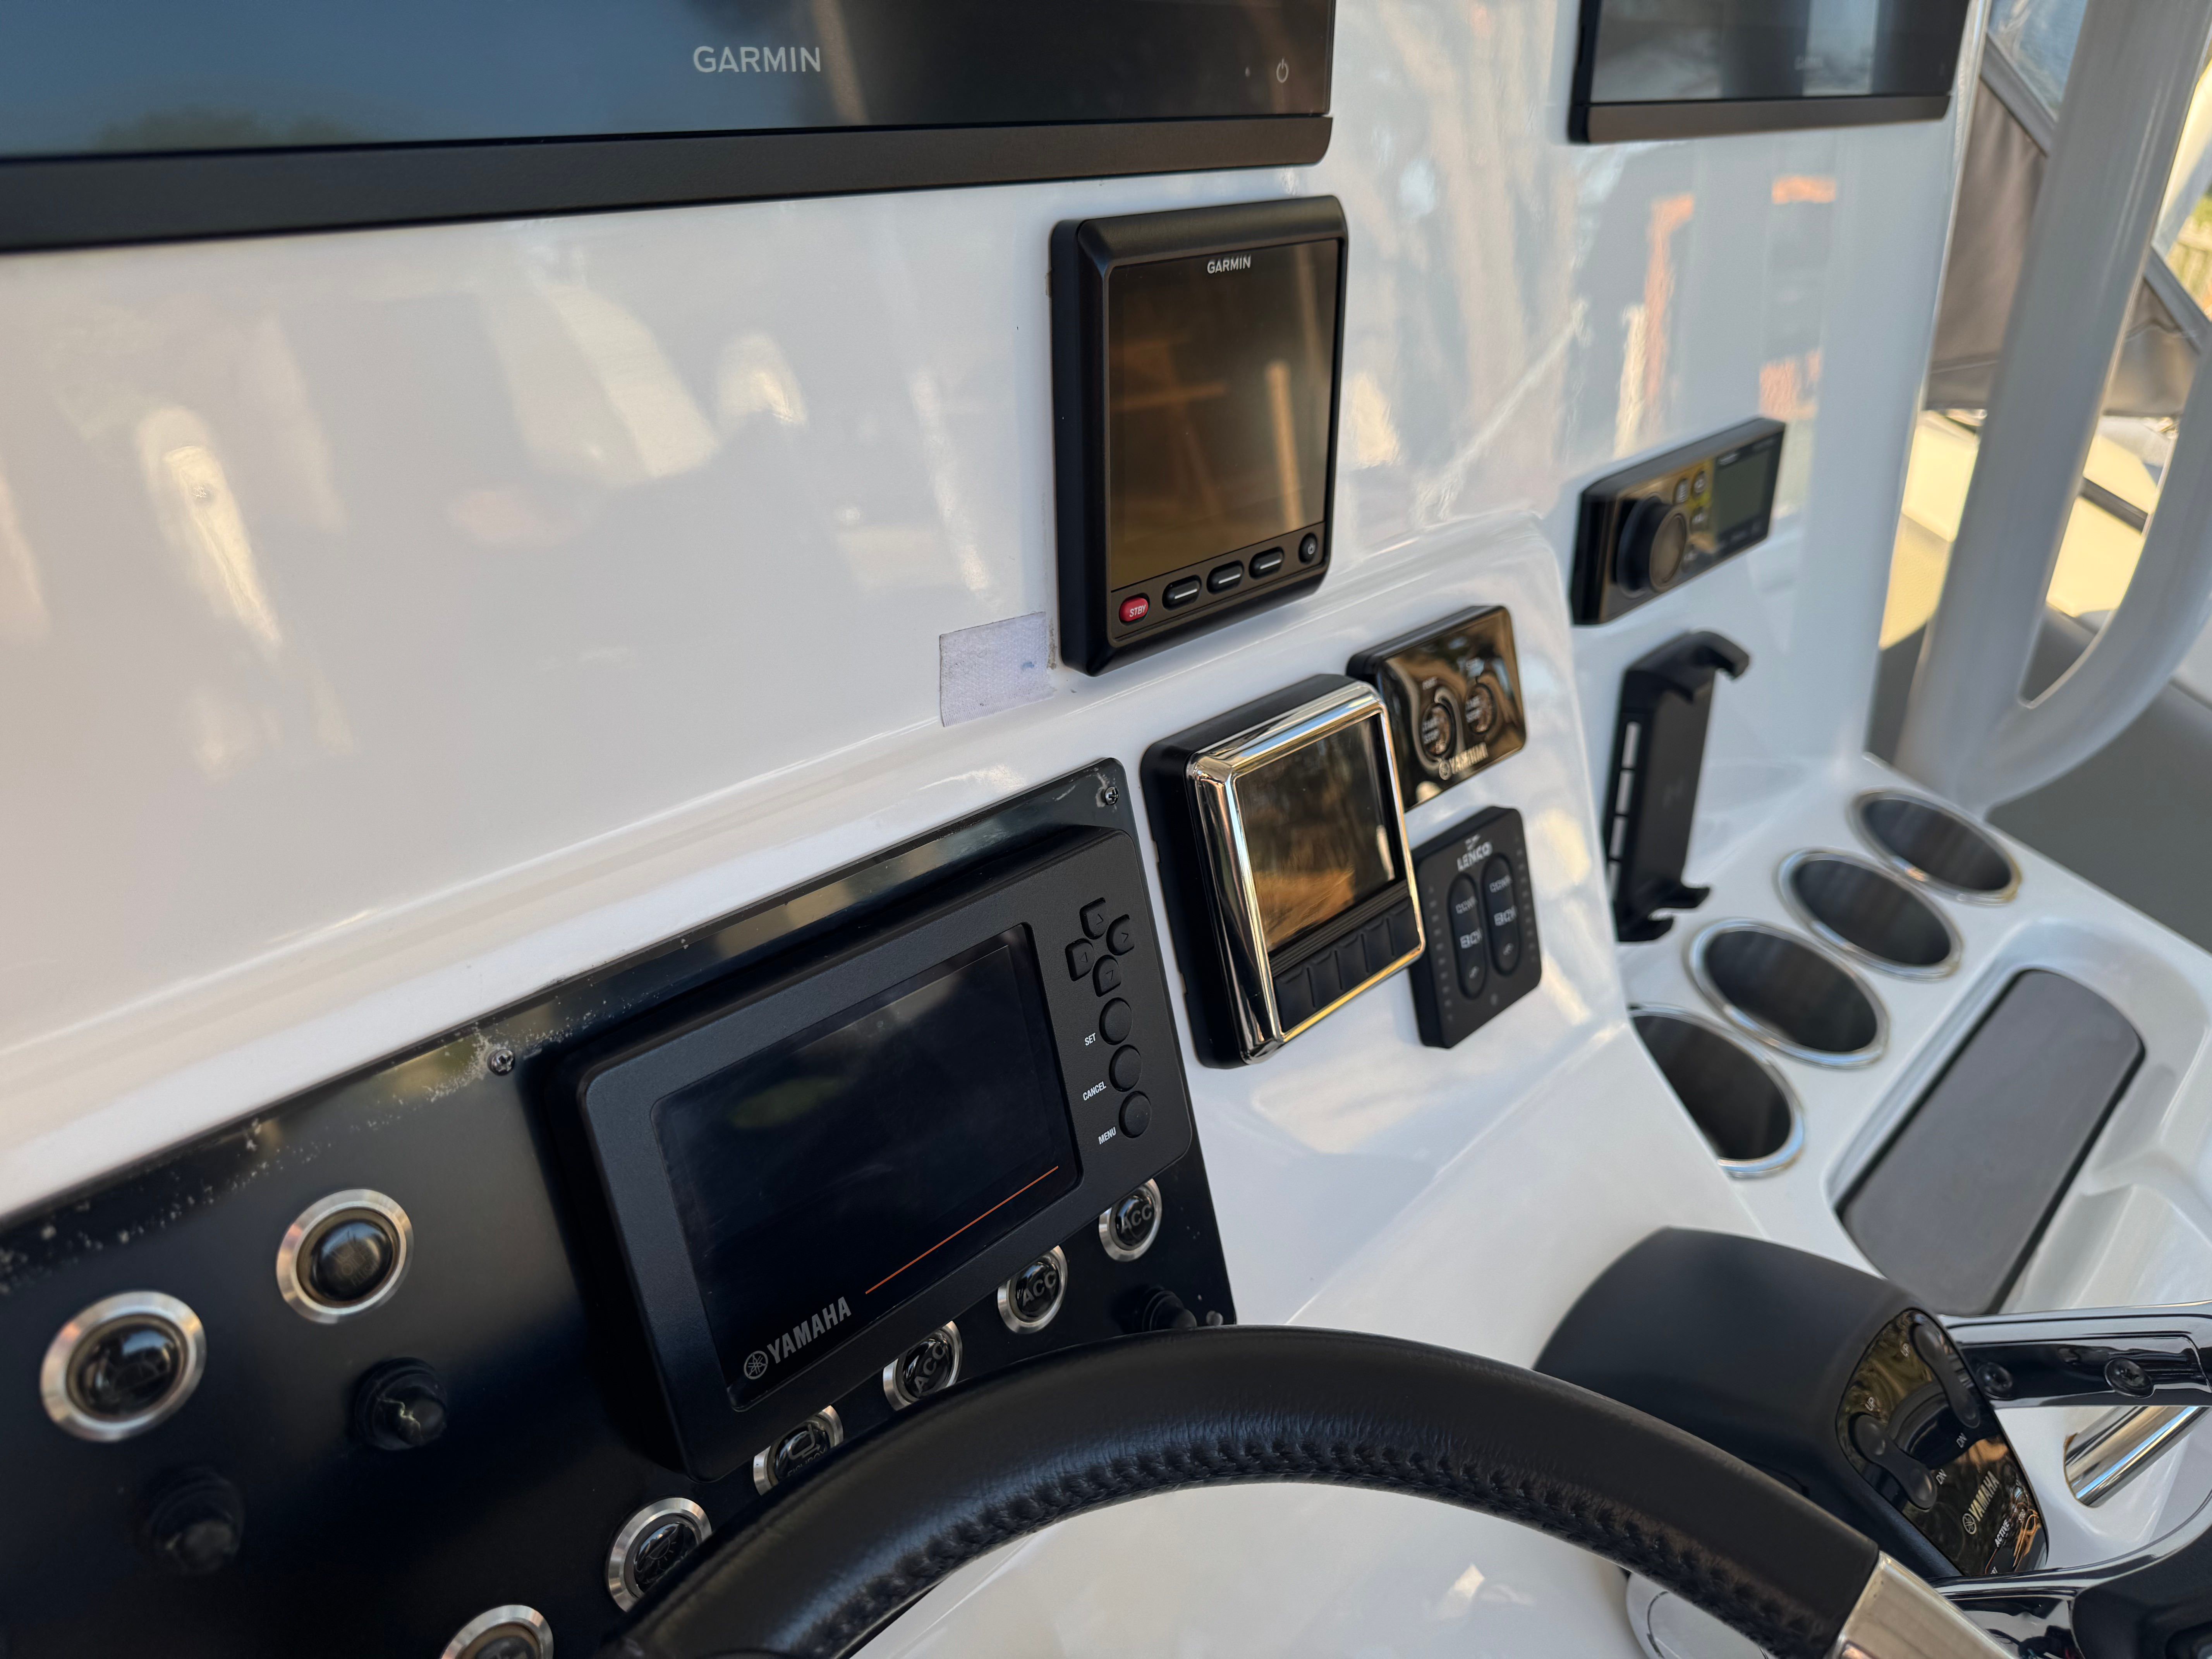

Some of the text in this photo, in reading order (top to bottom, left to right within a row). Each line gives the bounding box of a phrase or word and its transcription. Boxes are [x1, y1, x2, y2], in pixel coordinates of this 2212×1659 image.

[693, 46, 821, 72] GARMIN
[1207, 254, 1251, 274] GARMIN
[1129, 605, 1146, 618] STBY
[1457, 841, 1493, 872] LENCO
[1085, 1032, 1096, 1046] SET
[1083, 1081, 1106, 1101] CANCEL
[1098, 1127, 1116, 1145] MENU
[1122, 1204, 1152, 1233] ACC
[1023, 1271, 1057, 1307] ACC
[767, 1296, 852, 1364] YAMAHA
[1901, 1343, 1910, 1357] UP
[914, 1342, 945, 1394] ACC
[1865, 1396, 1875, 1412] UP
[1956, 1433, 1967, 1448] DN
[1936, 1469, 1947, 1485] DN
[1968, 1471, 2000, 1522] YAMAHA
[1994, 1519, 2009, 1548] ACTIVE
